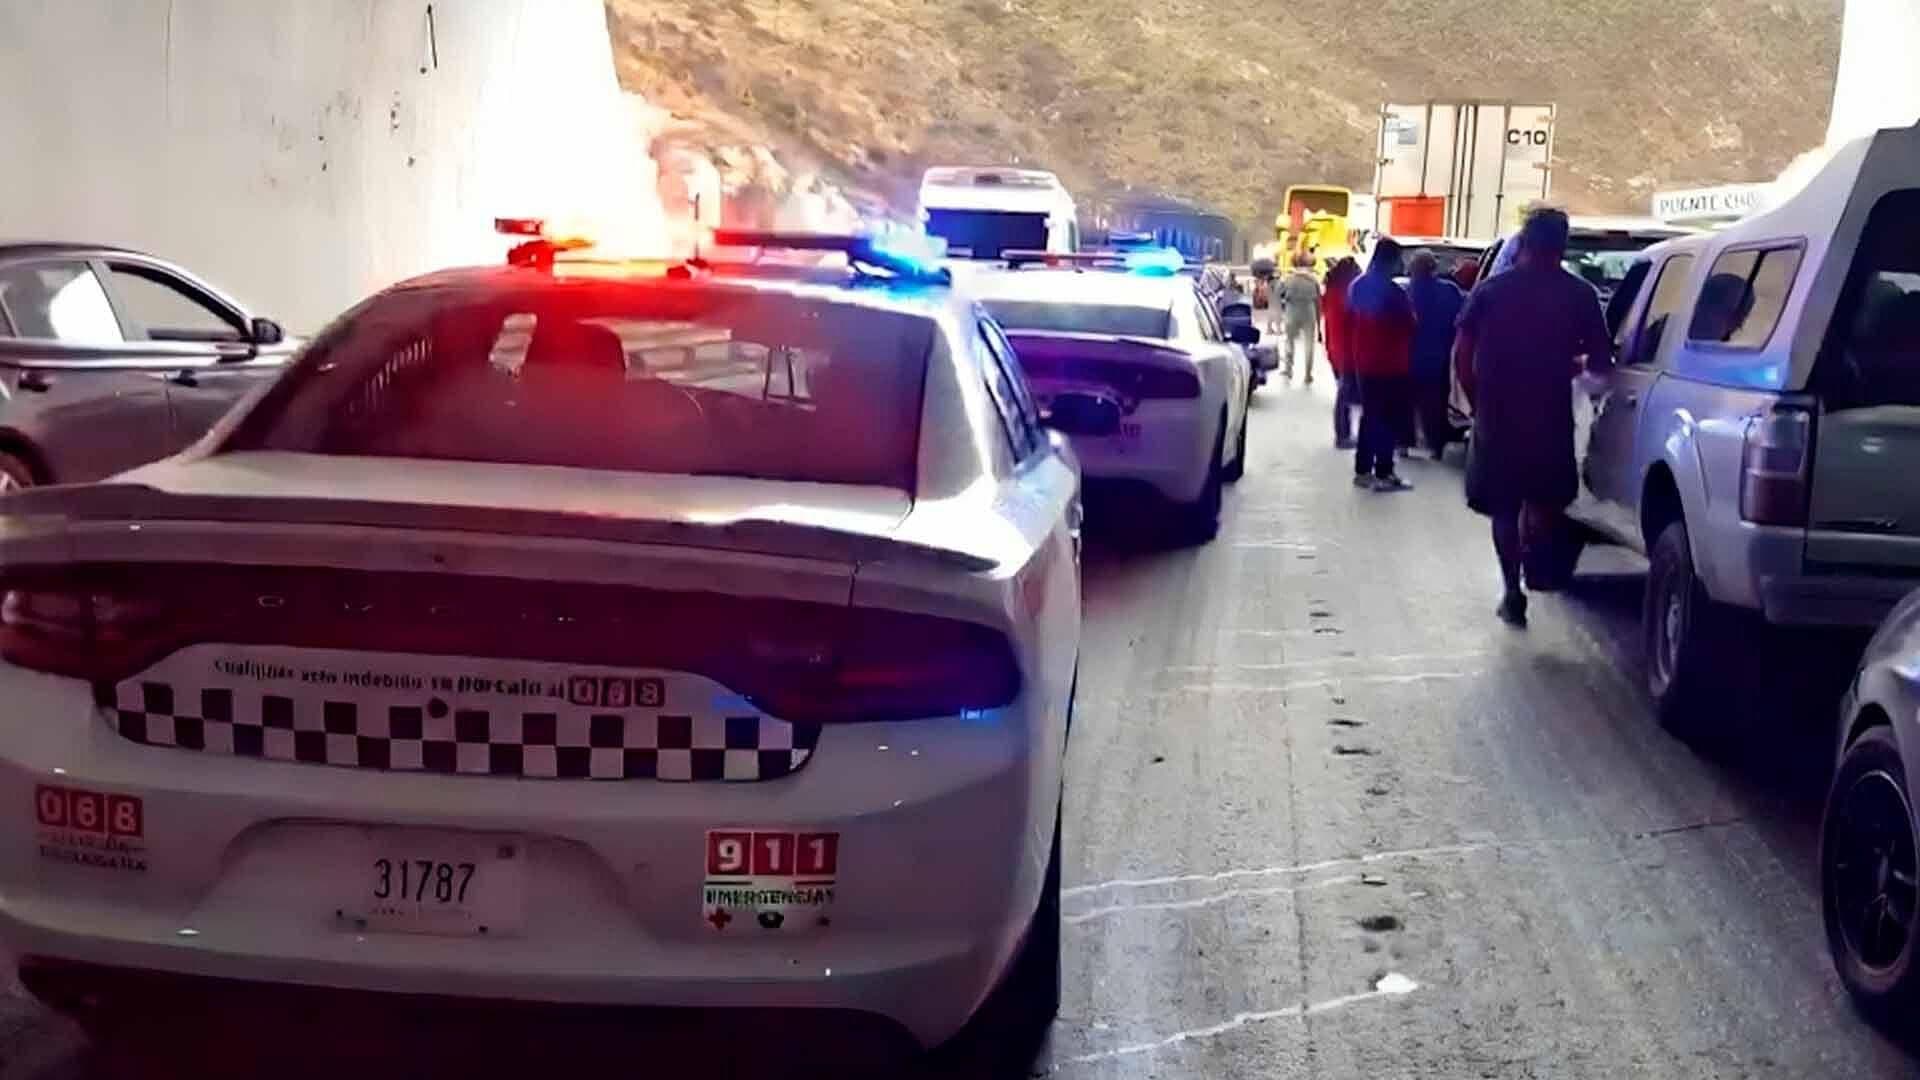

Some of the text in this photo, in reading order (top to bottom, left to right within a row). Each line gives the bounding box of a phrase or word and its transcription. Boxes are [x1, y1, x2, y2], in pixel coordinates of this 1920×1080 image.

[1506, 129, 1548, 147] C10
[714, 836, 829, 873] 911
[373, 857, 477, 903] 31787
